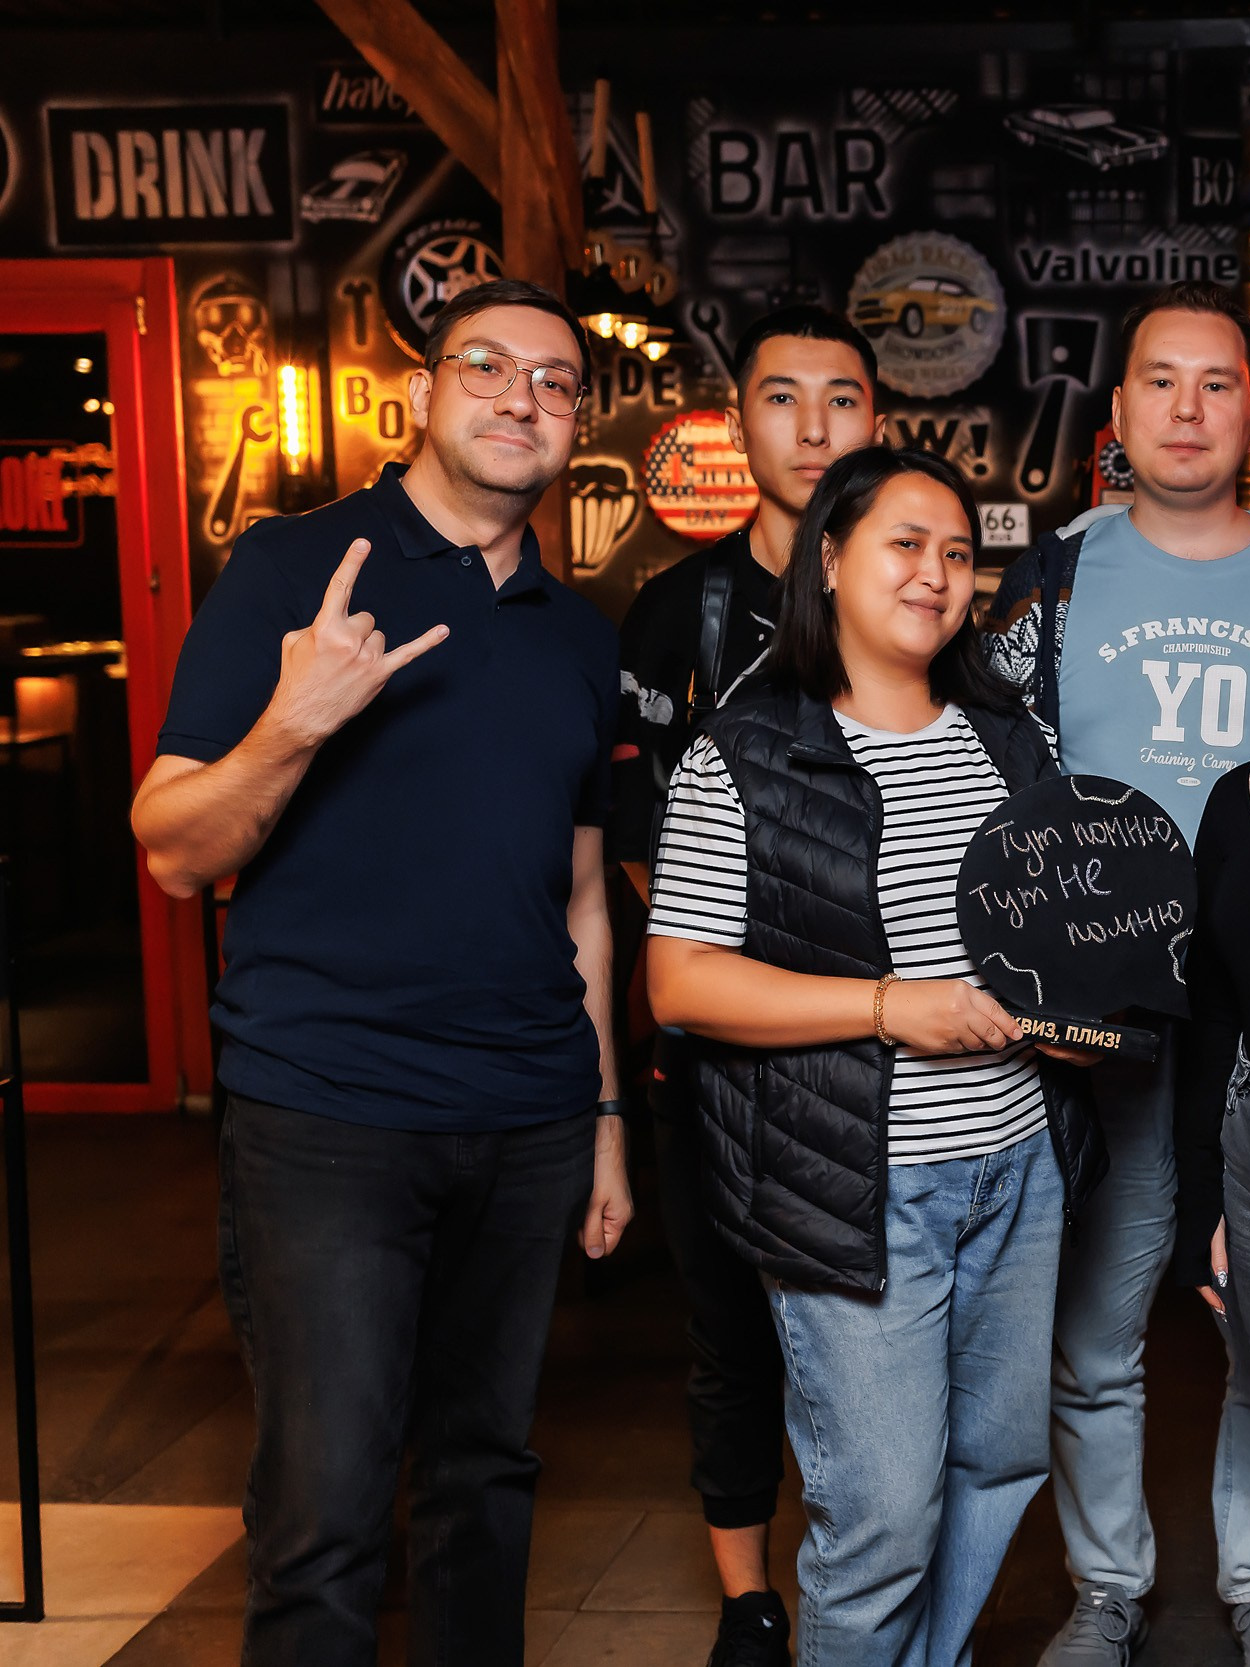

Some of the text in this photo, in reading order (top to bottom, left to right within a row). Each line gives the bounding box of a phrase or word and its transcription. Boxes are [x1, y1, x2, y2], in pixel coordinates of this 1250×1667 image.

[71, 128, 274, 219] DRINK
[709, 129, 886, 215] BAR
[1192, 157, 1234, 207] BO
[1020, 247, 1239, 281] Valvoline
[346, 376, 411, 438] BO
[884, 419, 989, 476] W!
[684, 508, 729, 526] DAY
[985, 508, 1016, 531] 66
[1163, 643, 1231, 657] CHAMPIONSHIP
[1142, 660, 1247, 748] YO
[1140, 747, 1239, 772] Training Camp
[985, 815, 1180, 877] Тут помню,
[968, 882, 1048, 929] Тут
[1065, 899, 1184, 947] помню
[1065, 1025, 1122, 1049] ПЛИЗ!
